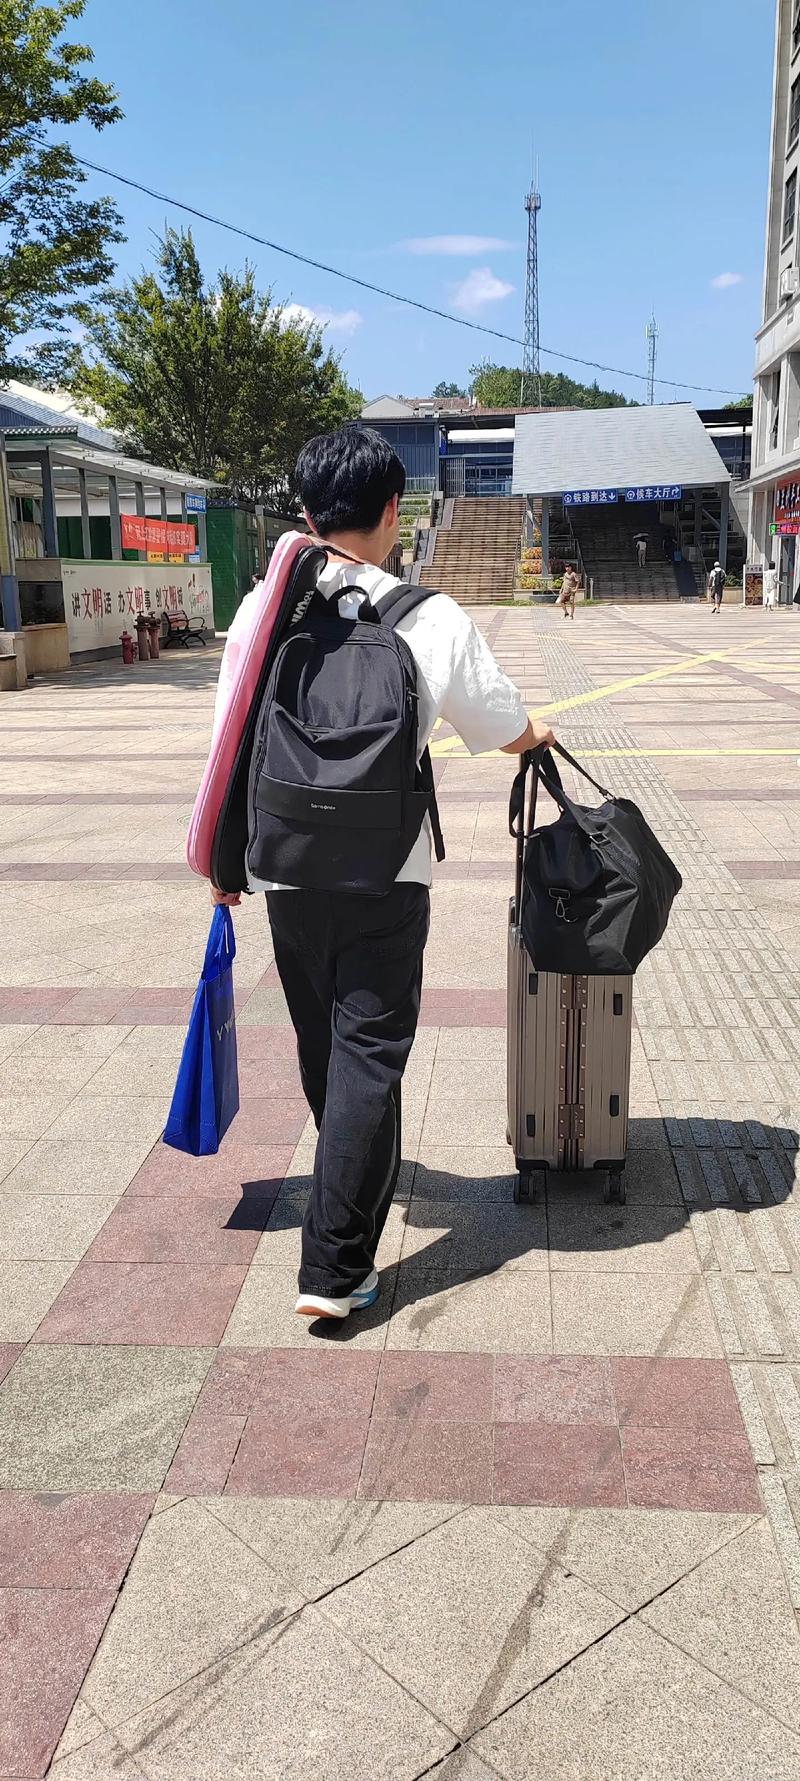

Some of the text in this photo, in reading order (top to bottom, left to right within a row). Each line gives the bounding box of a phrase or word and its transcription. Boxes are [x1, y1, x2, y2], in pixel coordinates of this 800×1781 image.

[573, 490, 608, 503] 铁路到达
[636, 487, 671, 500] 候车大厅
[71, 587, 112, 620] 讲文明话
[118, 585, 152, 616] 办文明事
[155, 585, 184, 611] 创文明城
